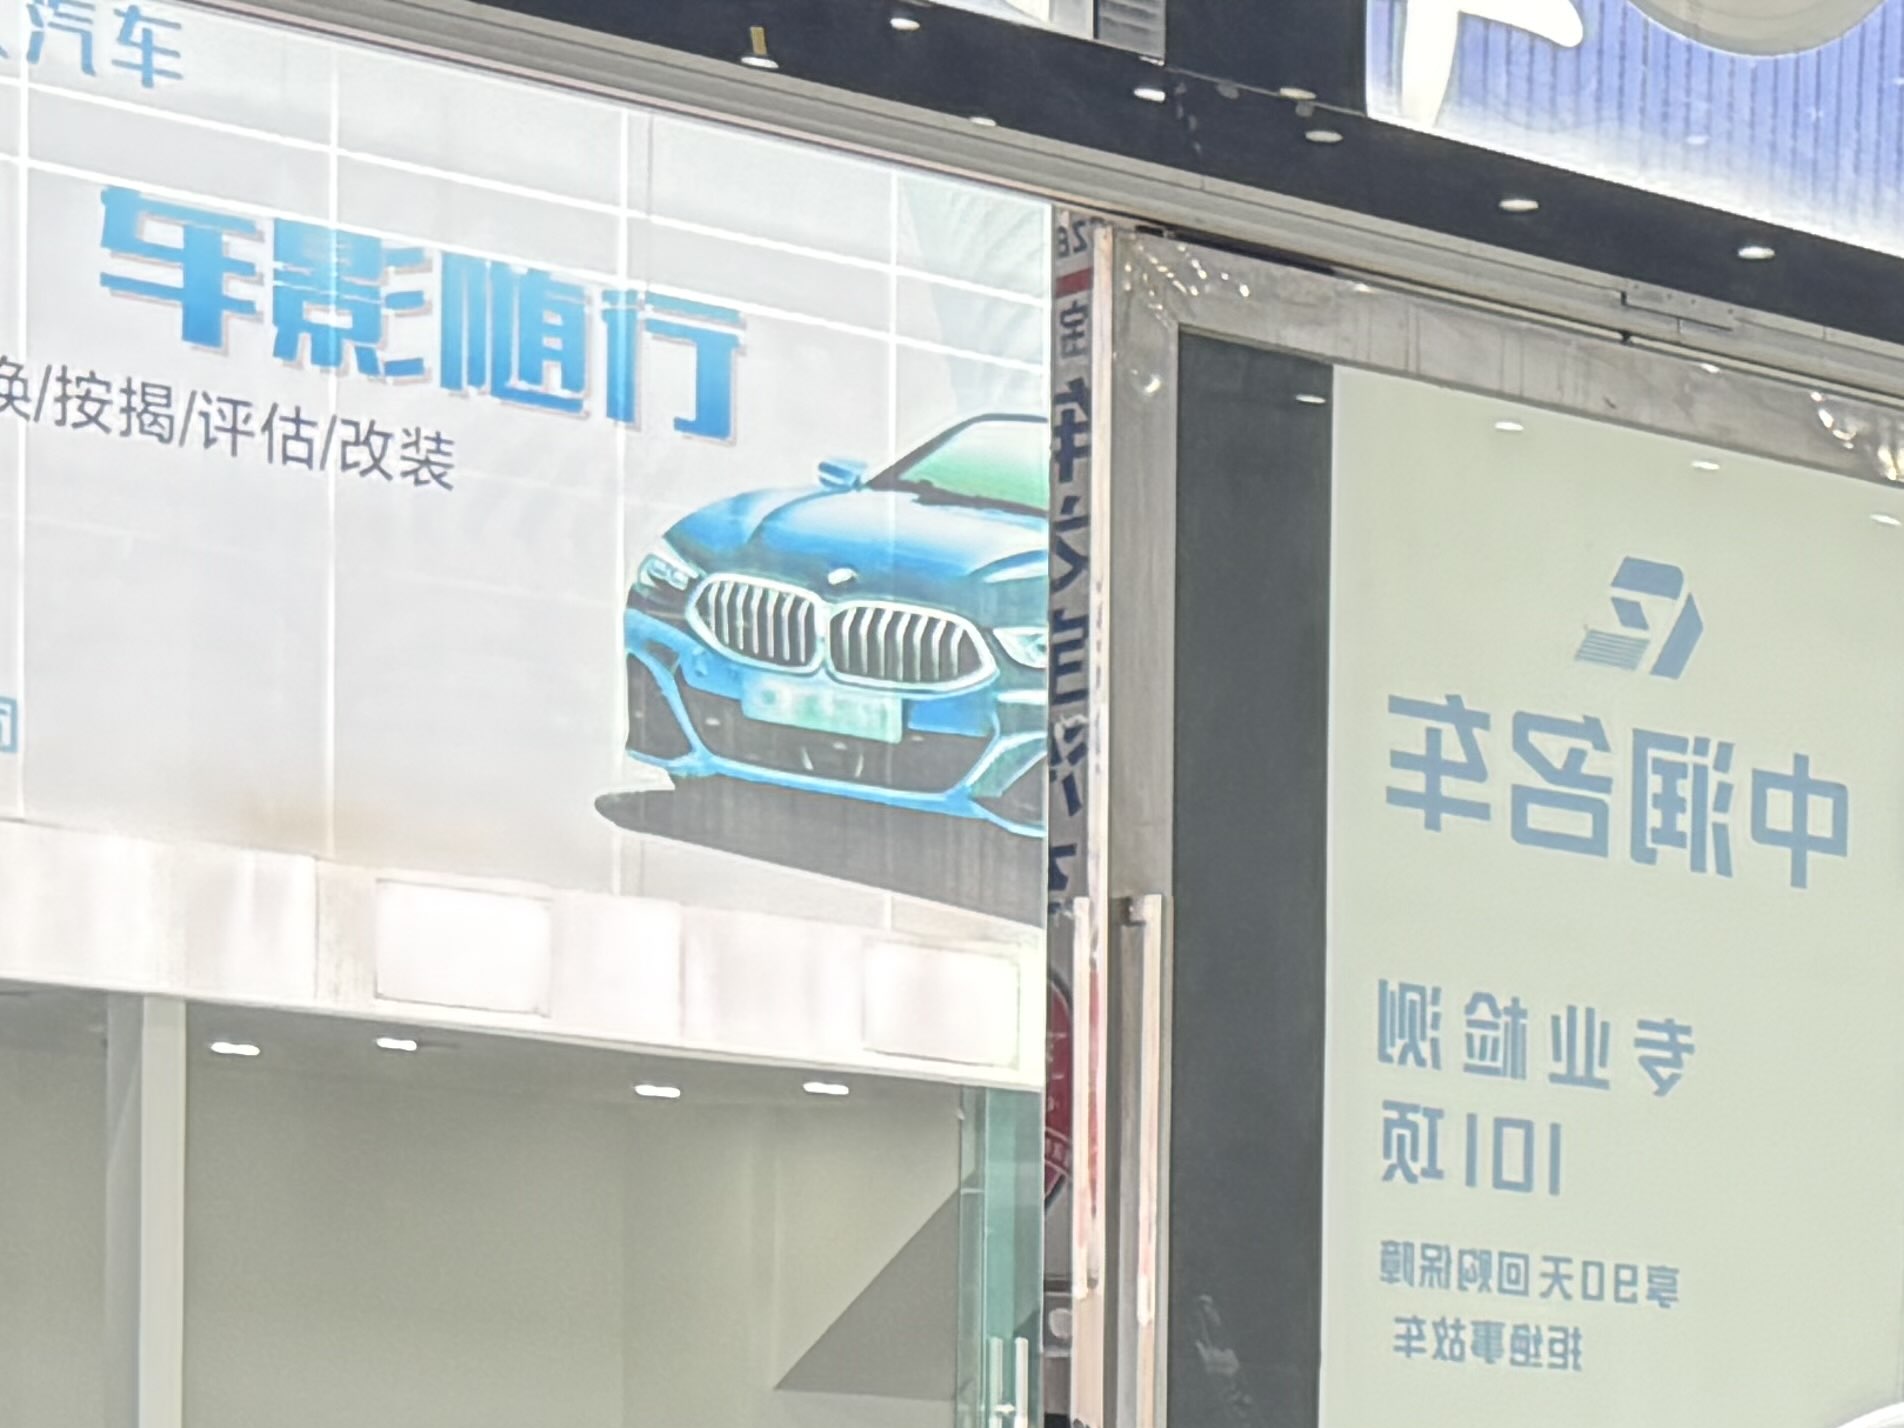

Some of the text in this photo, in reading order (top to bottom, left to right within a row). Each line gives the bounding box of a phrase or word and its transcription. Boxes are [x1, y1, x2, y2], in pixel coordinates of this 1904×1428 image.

[0, 0, 184, 88] 汽车
[100, 184, 744, 443] 车影随行
